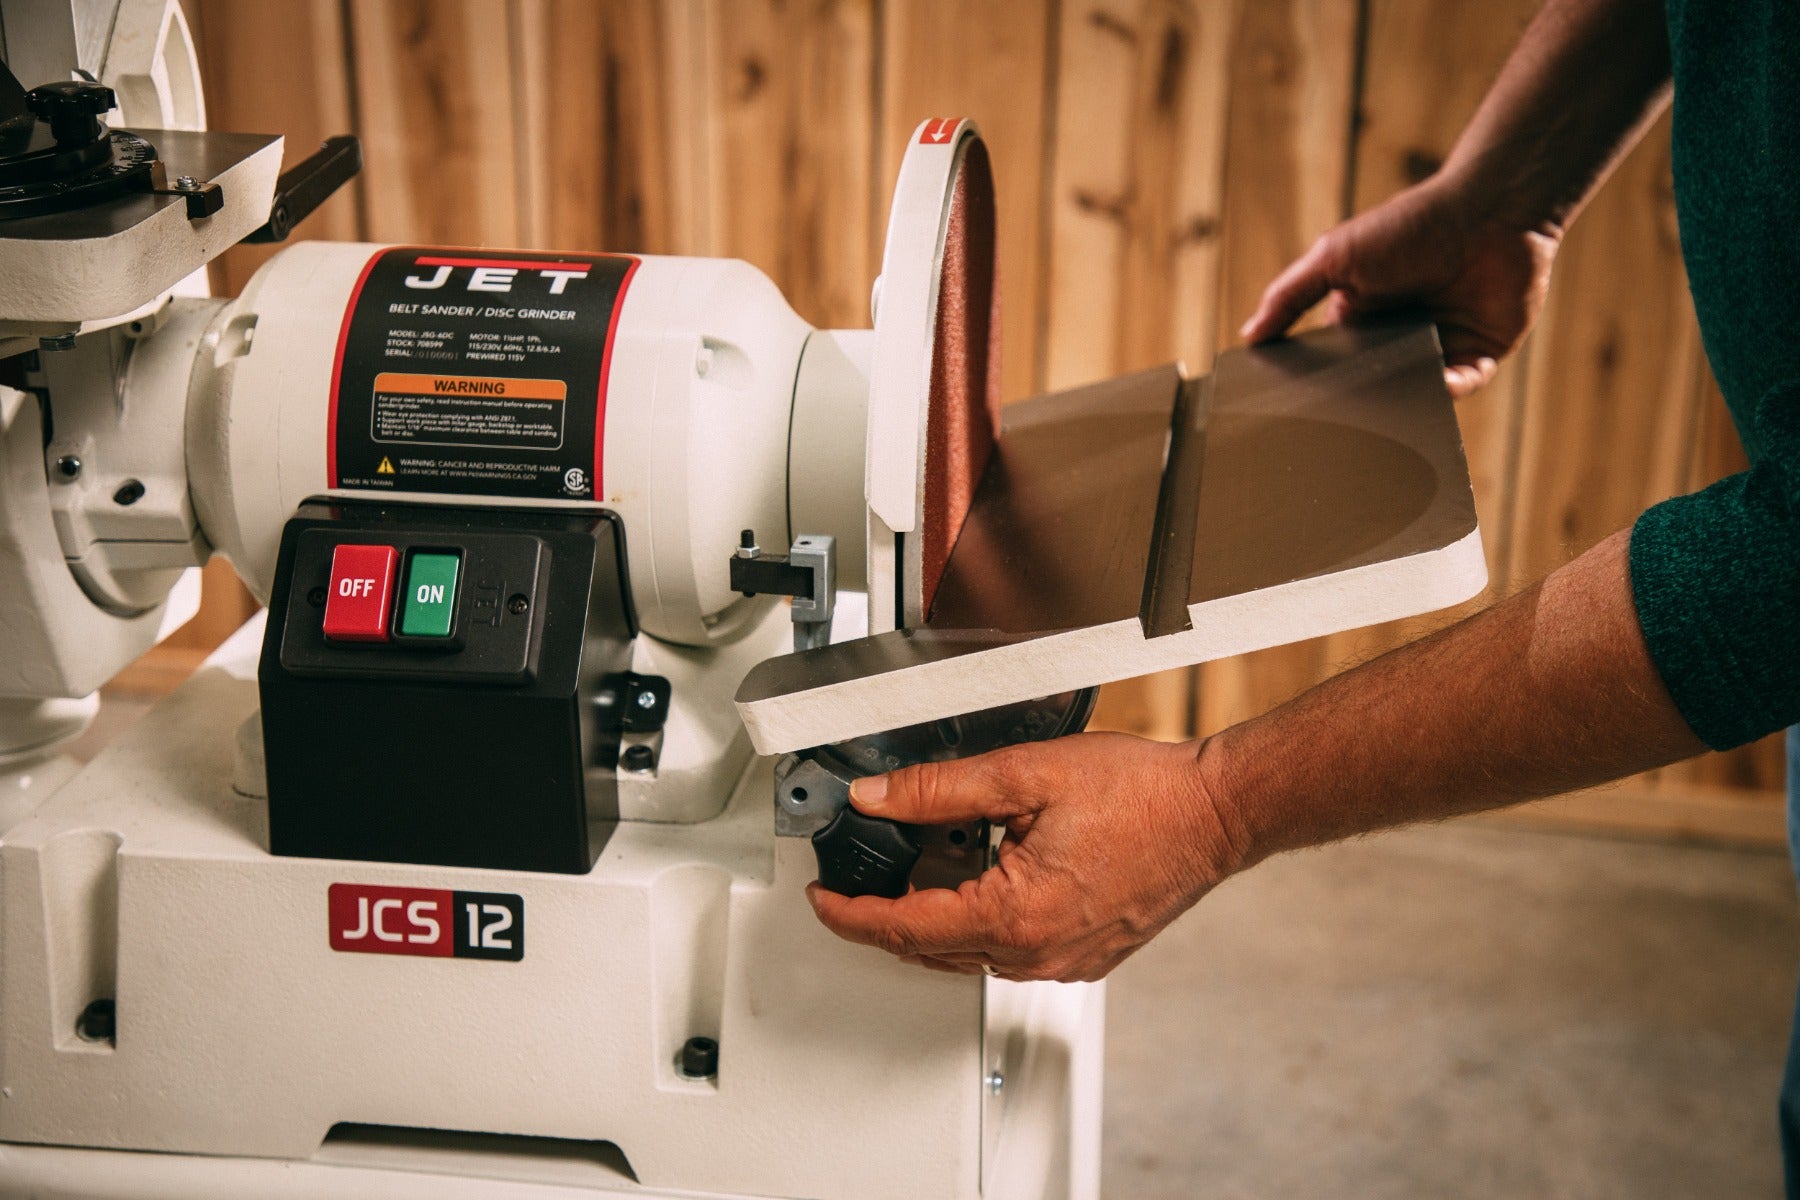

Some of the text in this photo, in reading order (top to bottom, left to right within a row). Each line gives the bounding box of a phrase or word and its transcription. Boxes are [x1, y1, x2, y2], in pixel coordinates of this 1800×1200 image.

[405, 265, 589, 295] JET
[389, 303, 577, 321] BELT SANDER / DISC GRINDER
[388, 329, 454, 340] MODEL: JSG-6DC
[469, 333, 500, 341] MOTOR:
[386, 338, 444, 348] STOCK: 708599
[384, 348, 413, 357] SERIAL:
[465, 352, 526, 362] PREWIRED 115V
[434, 380, 505, 394] WARNING
[524, 402, 553, 410] operating
[534, 430, 557, 438] sanding
[400, 459, 436, 467] WARNING:
[438, 460, 467, 468] CANCER
[468, 461, 485, 469] AND
[485, 462, 538, 472] REPRODUCTIVE
[342, 477, 360, 485] MADE
[339, 578, 375, 597] OFF
[416, 585, 444, 604] ON
[342, 897, 513, 949] JCS 12
